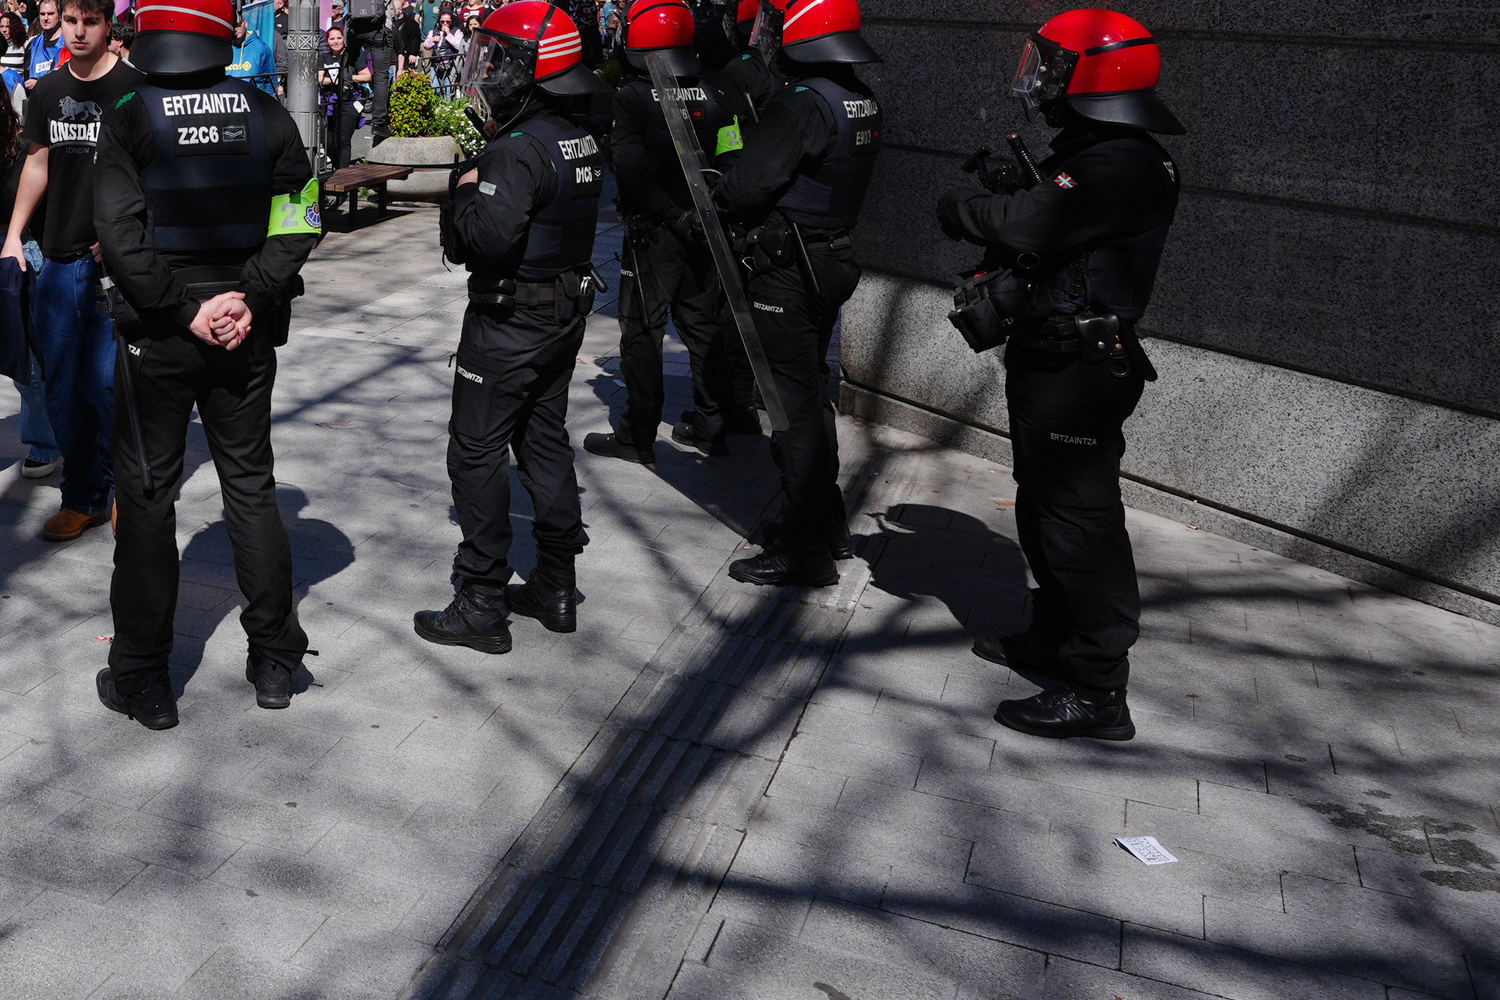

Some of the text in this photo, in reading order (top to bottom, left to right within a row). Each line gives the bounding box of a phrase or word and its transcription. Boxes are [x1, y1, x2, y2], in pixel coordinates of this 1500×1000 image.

[162, 93, 250, 116] ERTZAINTZA
[178, 126, 219, 145] Z2C6
[726, 130, 739, 146] 2
[558, 134, 599, 160] ERTZAINTZA
[281, 203, 299, 228] 2
[1050, 432, 1097, 445] ERTZAINTZA
